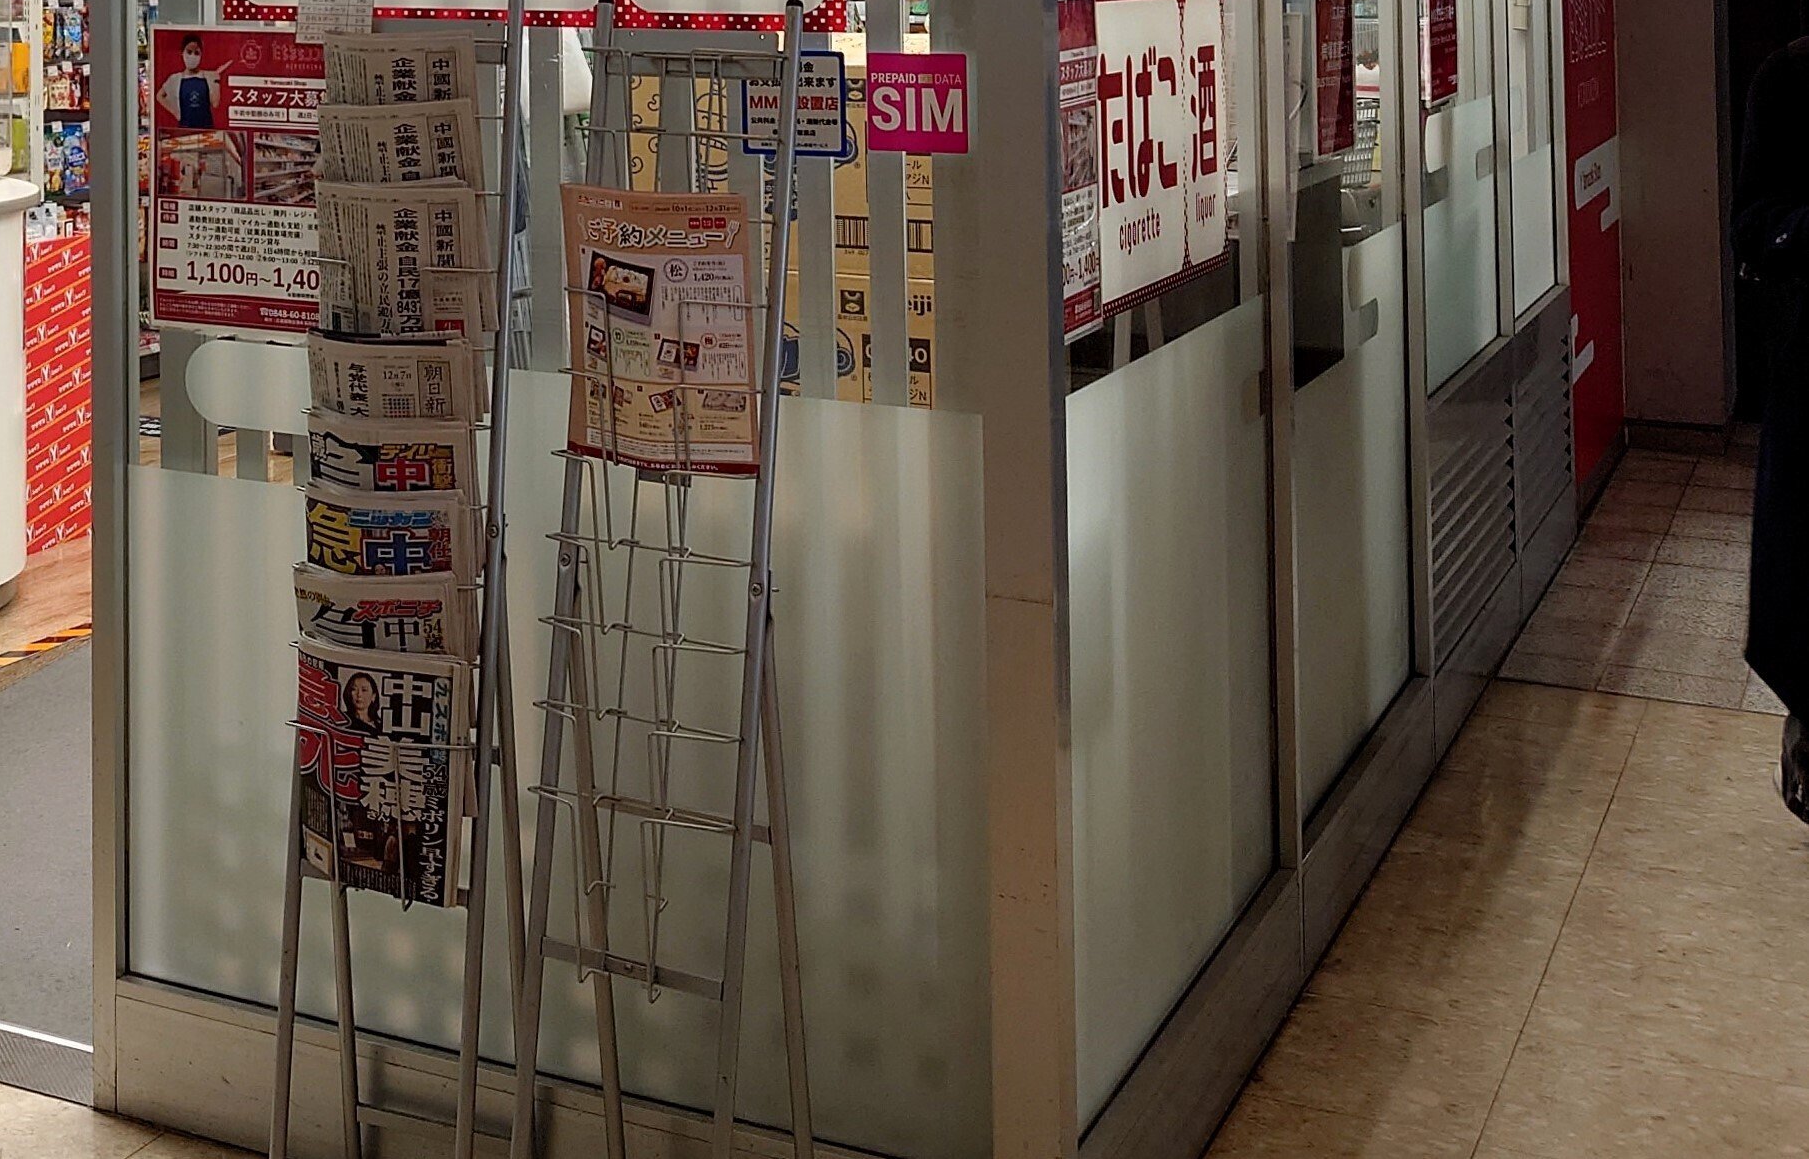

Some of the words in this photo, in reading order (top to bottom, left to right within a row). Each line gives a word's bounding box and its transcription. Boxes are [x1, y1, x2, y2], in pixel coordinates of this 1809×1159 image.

[871, 72, 916, 85] PREPAID
[934, 73, 962, 85] DATA
[872, 86, 964, 134] SIM
[1097, 45, 1179, 210] たばこ
[1189, 43, 1218, 185] 酒
[393, 123, 422, 168] 企業献金
[393, 207, 420, 253] 企業献金
[587, 217, 725, 249] ご予約メニュー
[1119, 209, 1161, 257] cigarette
[1194, 192, 1217, 229] liquor
[669, 263, 684, 278] 松
[379, 443, 454, 460] デイリー
[352, 599, 444, 622] スポニチ
